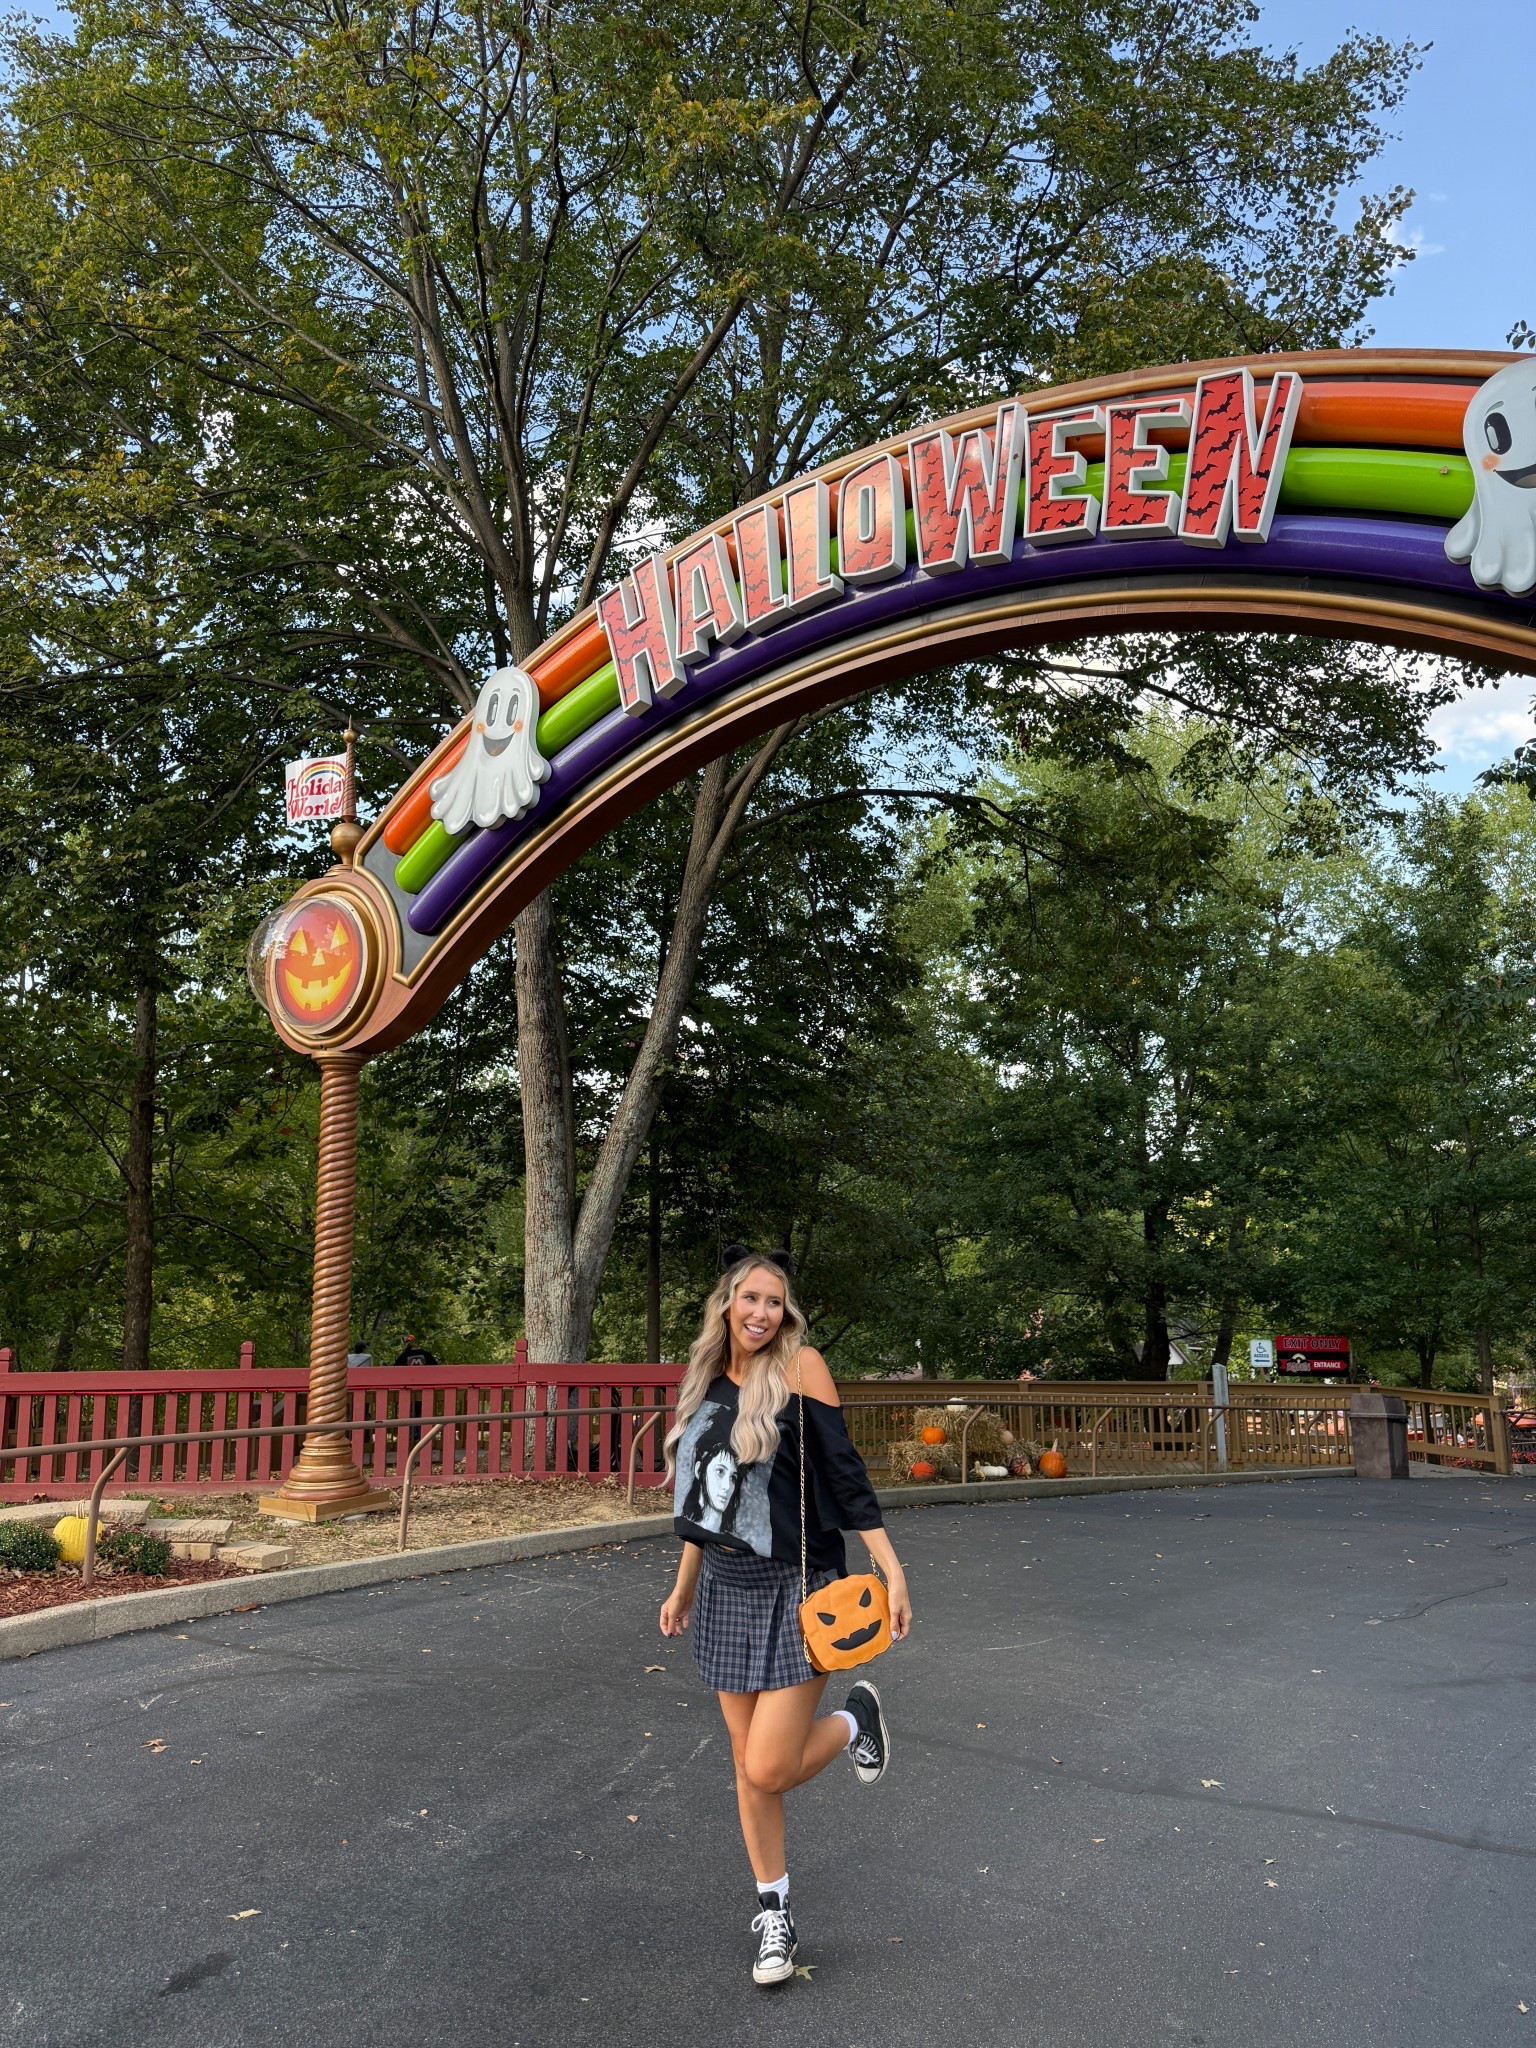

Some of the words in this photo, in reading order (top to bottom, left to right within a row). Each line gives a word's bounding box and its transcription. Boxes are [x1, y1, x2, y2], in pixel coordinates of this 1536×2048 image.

[596, 366, 1303, 717] HALLOWEEN
[288, 796, 340, 819] World
[1284, 1338, 1308, 1349] EXIT
[1311, 1338, 1341, 1350] ONLY
